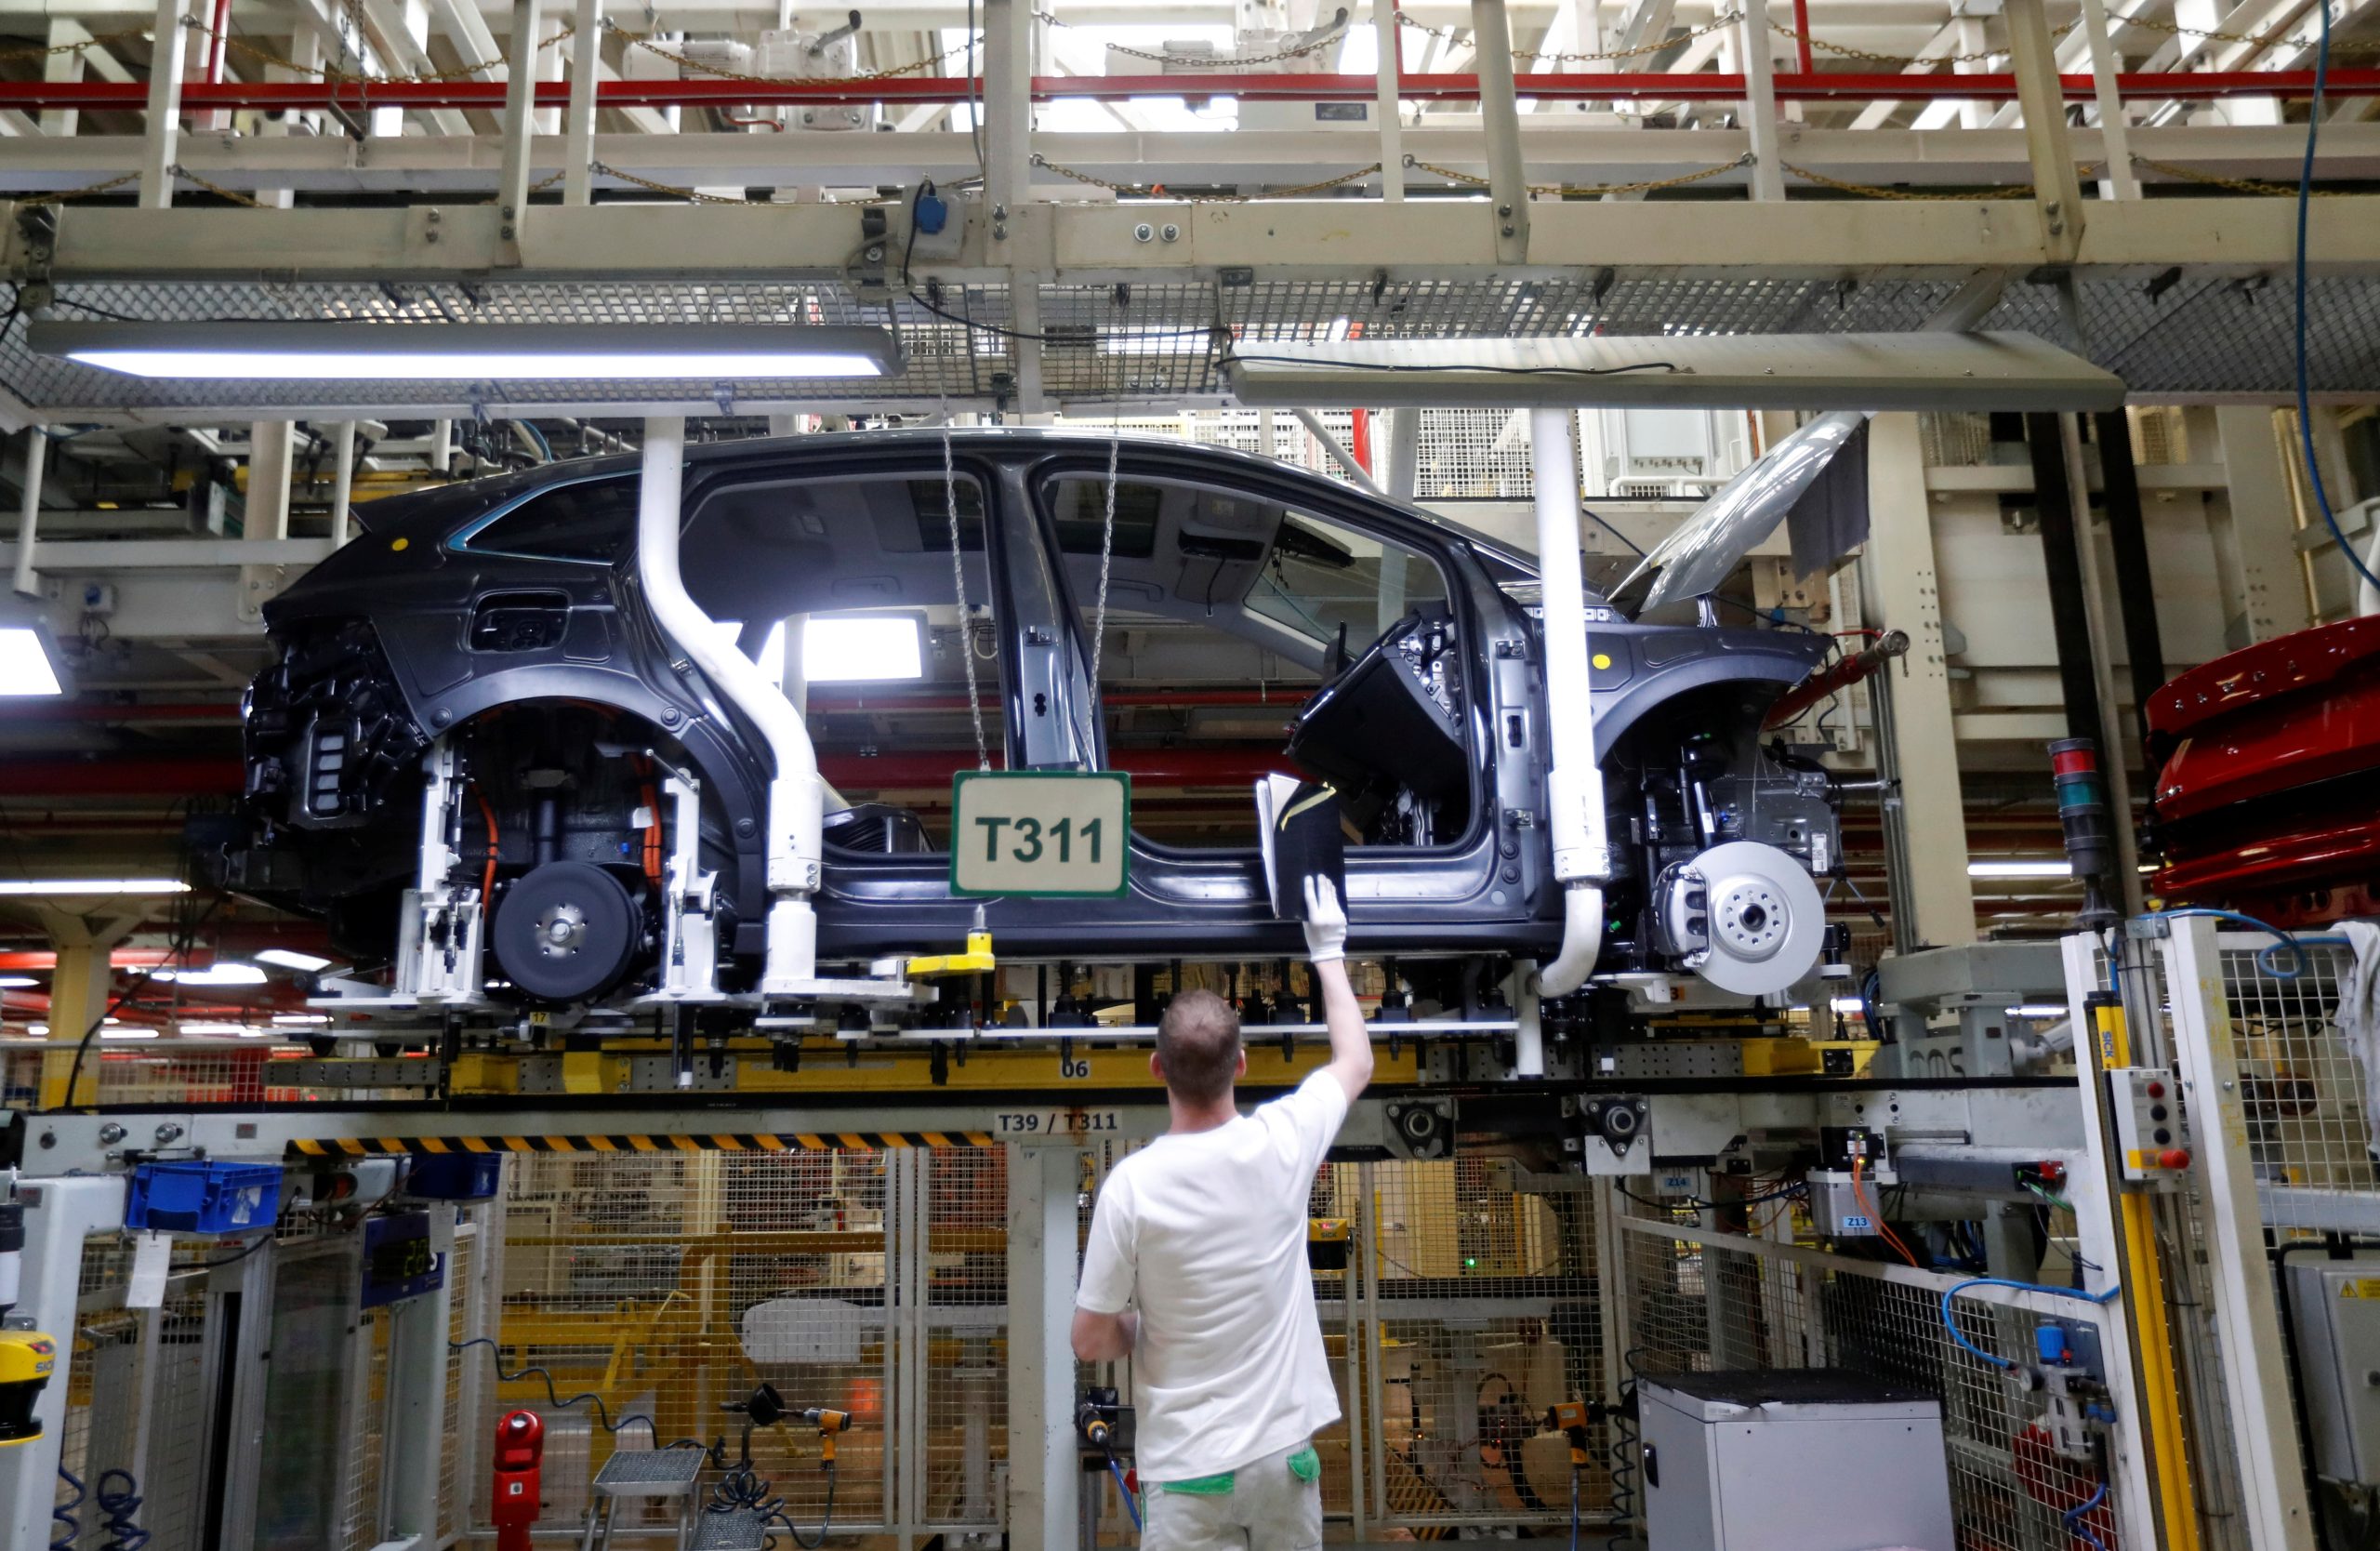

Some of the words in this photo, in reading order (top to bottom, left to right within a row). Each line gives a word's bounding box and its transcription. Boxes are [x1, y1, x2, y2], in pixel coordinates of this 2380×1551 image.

[974, 816, 1102, 863] T311
[533, 1012, 547, 1023] 17
[2101, 1031, 2114, 1057] SICK
[1062, 1061, 1089, 1078] 06
[998, 1114, 1038, 1132] T39
[1047, 1113, 1056, 1134] /
[1064, 1113, 1117, 1131] T311
[1668, 1177, 1686, 1186] Z14
[1847, 1217, 1868, 1226] Z13
